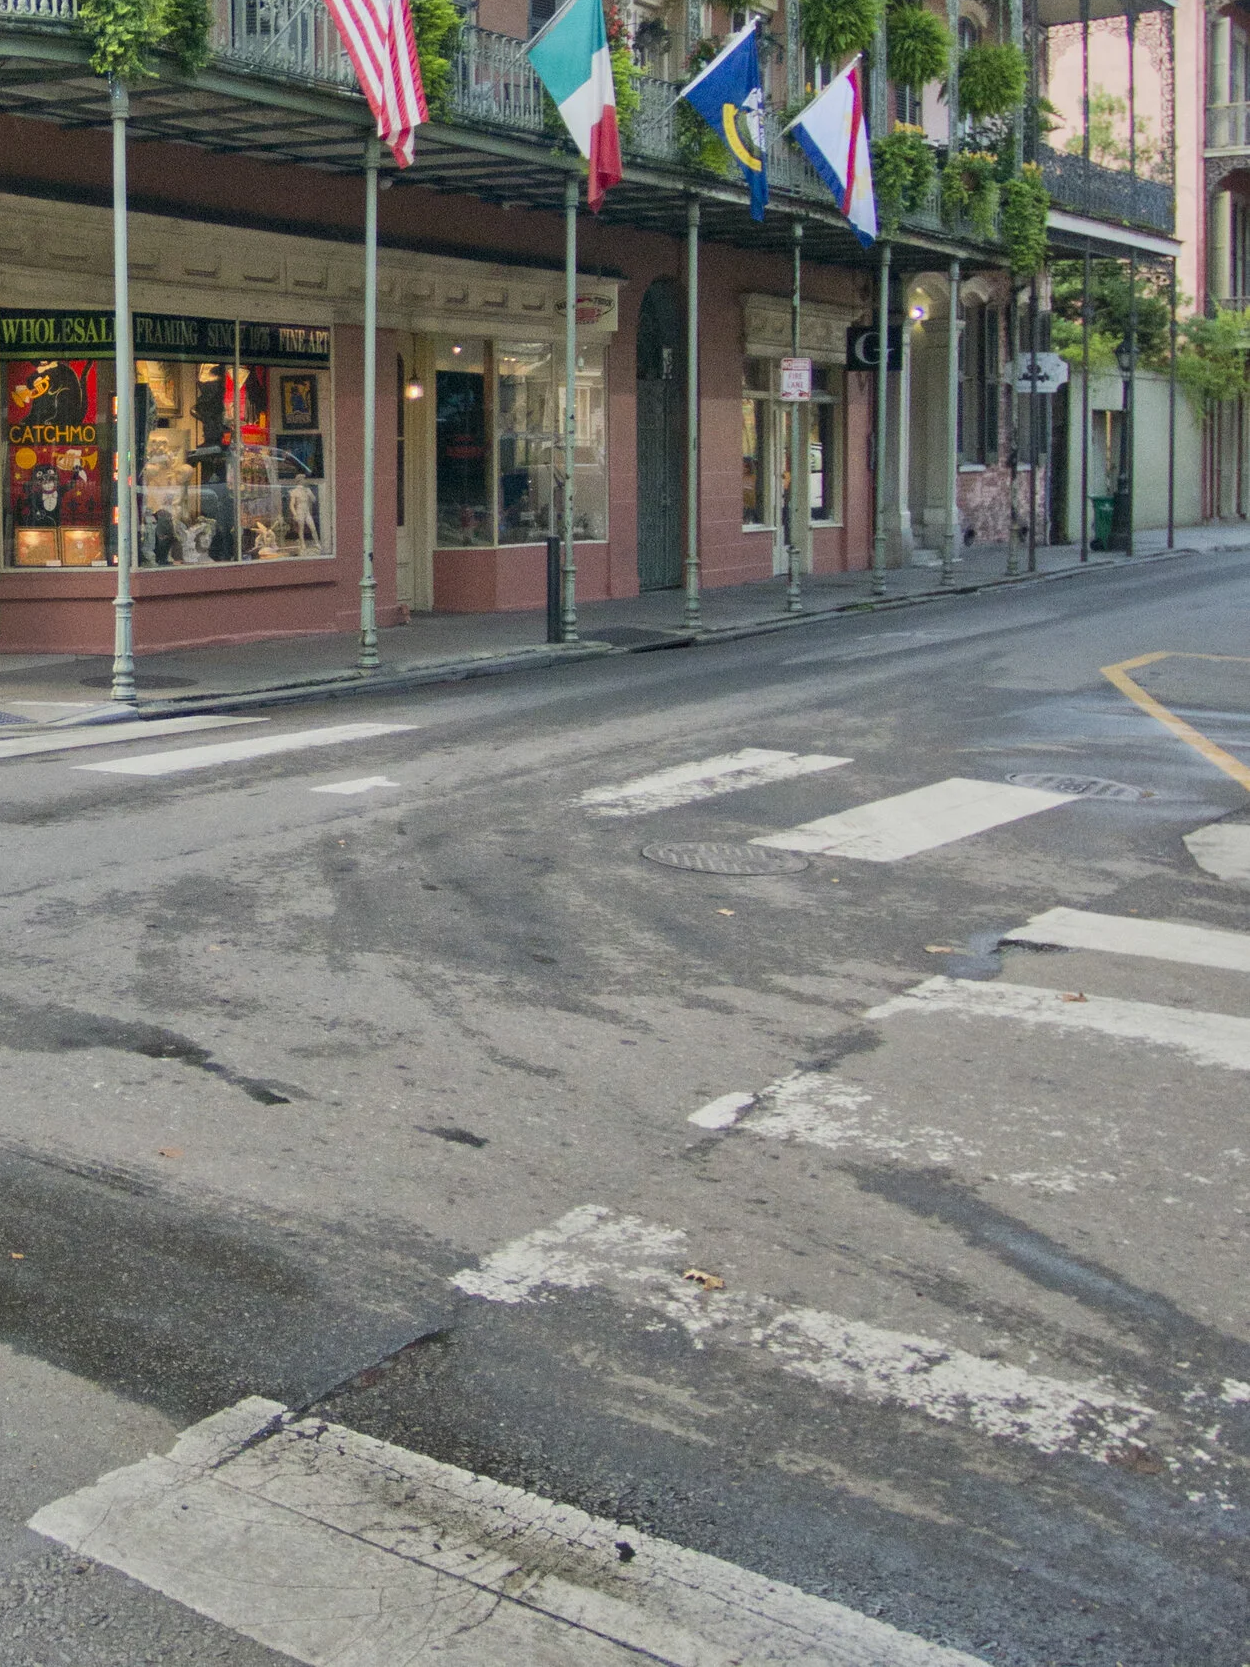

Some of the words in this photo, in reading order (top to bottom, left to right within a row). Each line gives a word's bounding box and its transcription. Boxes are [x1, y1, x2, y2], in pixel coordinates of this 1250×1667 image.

[1, 317, 116, 344] WHOLESAL
[136, 317, 198, 346] FRAMING
[278, 328, 305, 353] FINE
[308, 331, 330, 354] ART
[786, 381, 803, 389] LANE
[788, 372, 803, 380] FIRE
[9, 425, 96, 444] CATCHMO
